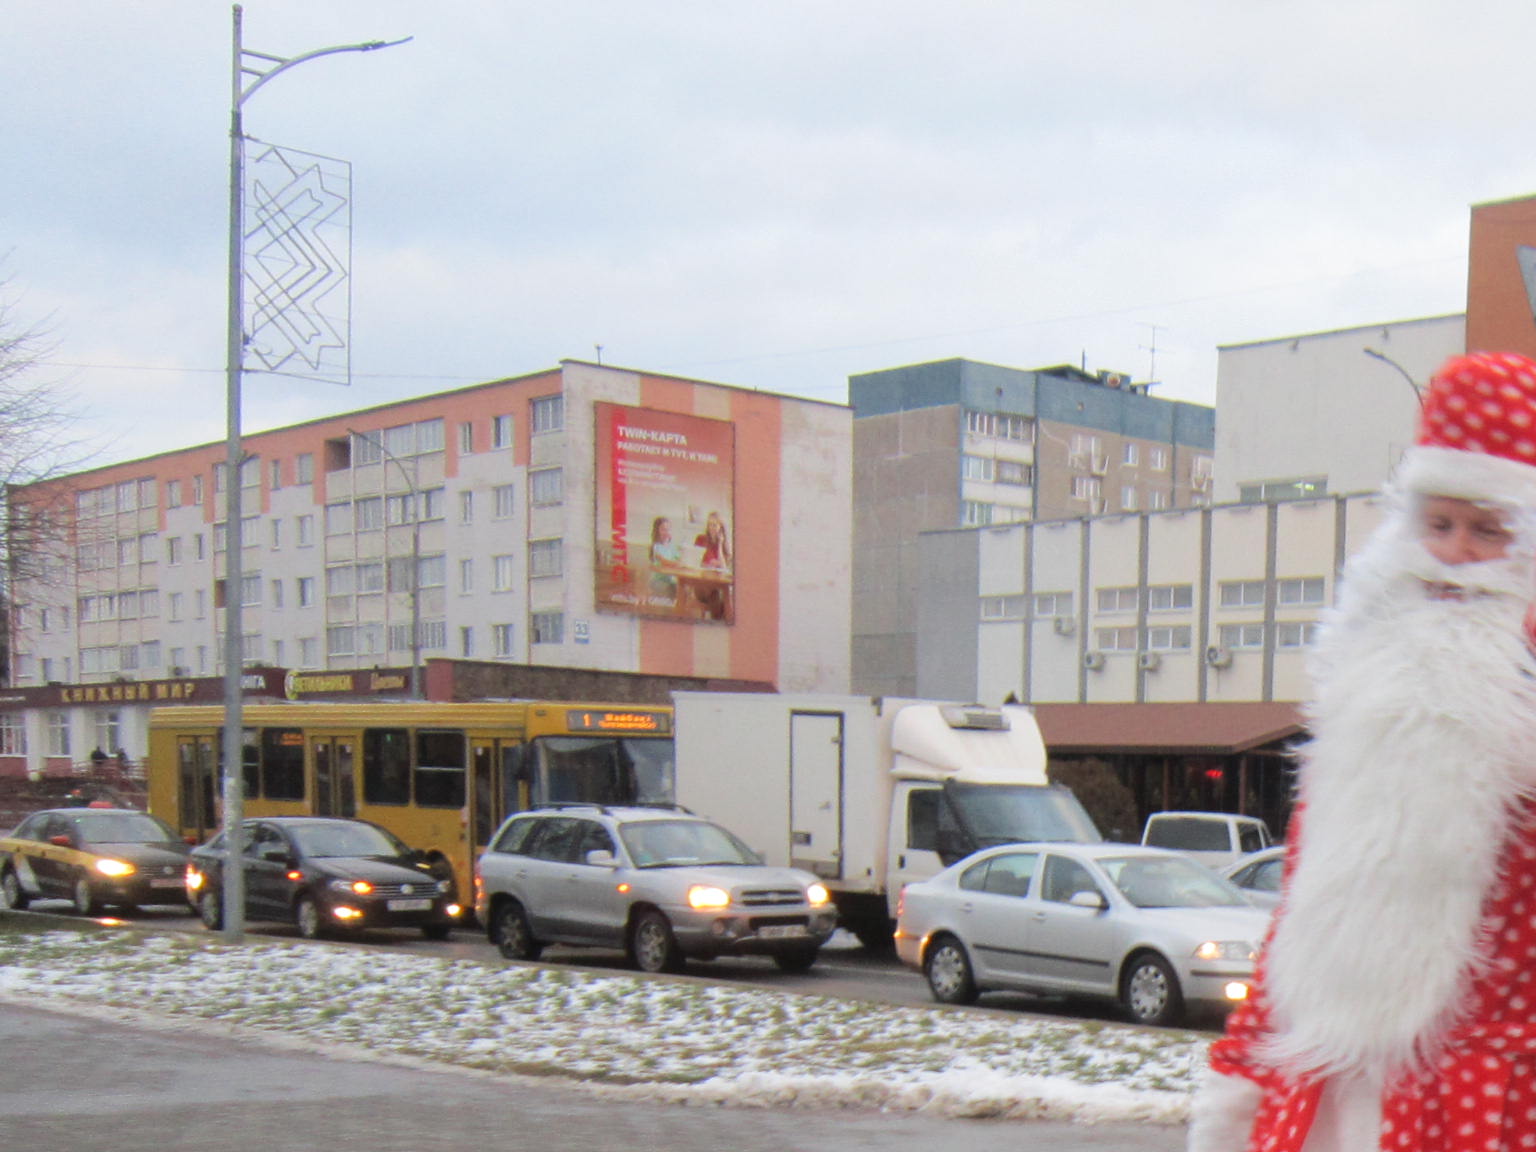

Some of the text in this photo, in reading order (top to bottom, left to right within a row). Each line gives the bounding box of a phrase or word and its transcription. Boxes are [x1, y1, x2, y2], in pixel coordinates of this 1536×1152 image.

[61, 682, 195, 702] КНИЖНЫЙ МИР
[583, 712, 592, 728] 1
